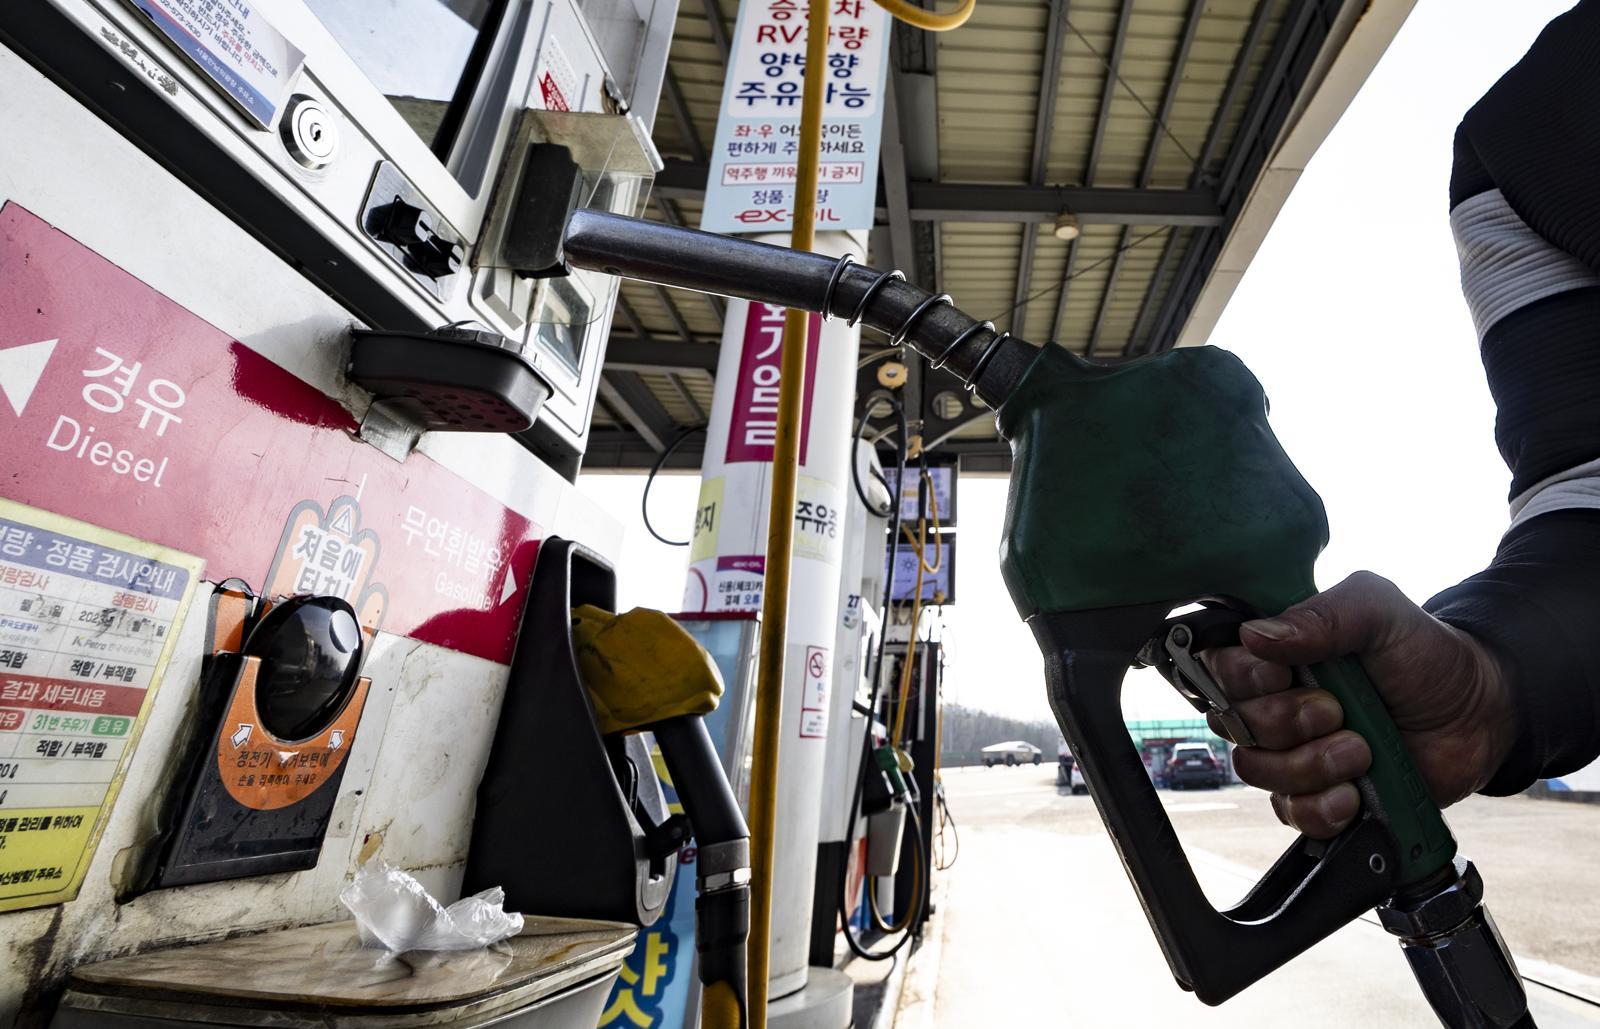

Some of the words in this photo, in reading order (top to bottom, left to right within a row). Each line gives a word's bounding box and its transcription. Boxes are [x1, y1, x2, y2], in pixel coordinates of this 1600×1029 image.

[768, 0, 864, 20] 승차
[756, 25, 869, 50] RV량
[727, 141, 777, 157] 편하게
[782, 141, 864, 155] 주하세요
[727, 167, 768, 181] 역주행
[832, 166, 858, 179] 금지
[82, 346, 187, 437] 경유
[46, 415, 169, 488] Diesel
[297, 528, 362, 581] 처음에
[400, 504, 502, 583] 무연휘발유
[46, 538, 96, 574] 정품
[96, 552, 178, 594] 검사안내
[847, 594, 860, 608] 27
[70, 659, 95, 678] 적합
[103, 664, 136, 682] 부적합
[1, 680, 40, 702] 결과
[39, 684, 108, 708] 세부내용
[36, 740, 63, 757] 적합
[72, 742, 107, 758] 부적합
[237, 750, 273, 769] 정전기
[53, 814, 85, 830] 위하여
